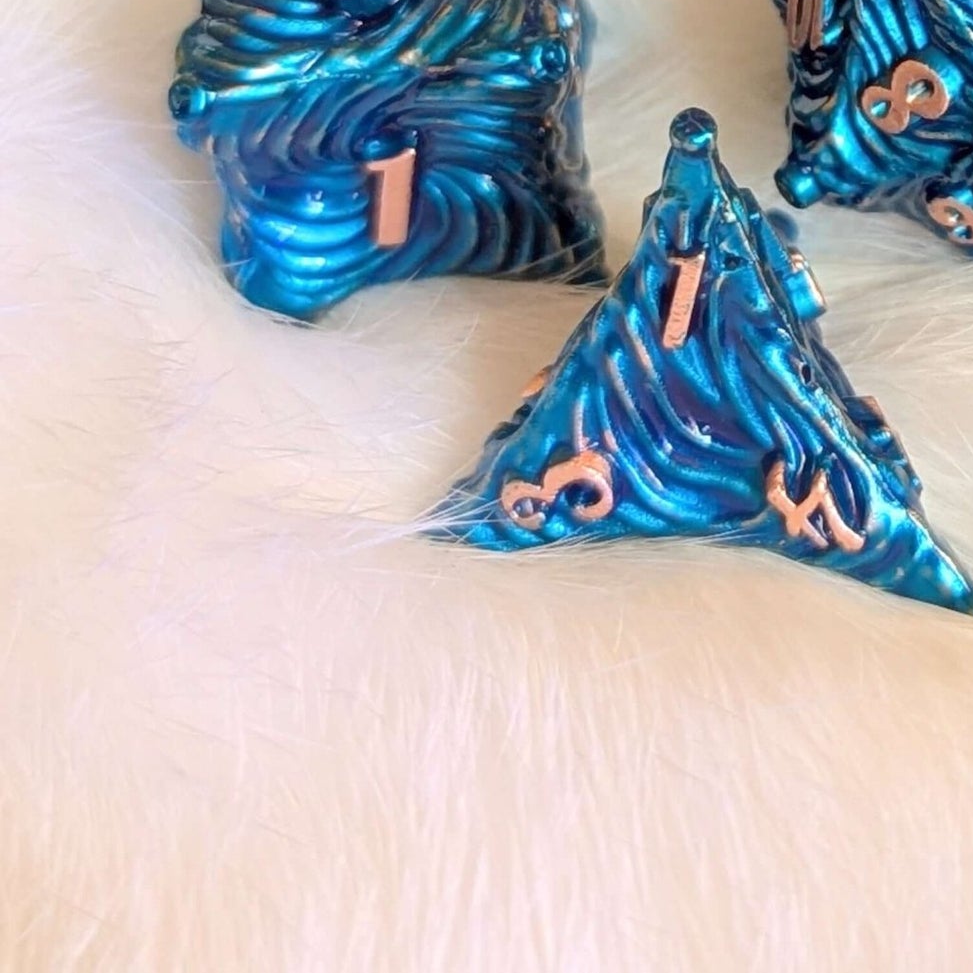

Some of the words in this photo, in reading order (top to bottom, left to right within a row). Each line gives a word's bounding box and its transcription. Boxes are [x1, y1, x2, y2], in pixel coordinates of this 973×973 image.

[861, 59, 951, 135] 8
[364, 148, 417, 248] 1
[662, 253, 705, 349] 1
[501, 449, 614, 528] 3
[766, 459, 866, 553] 4
